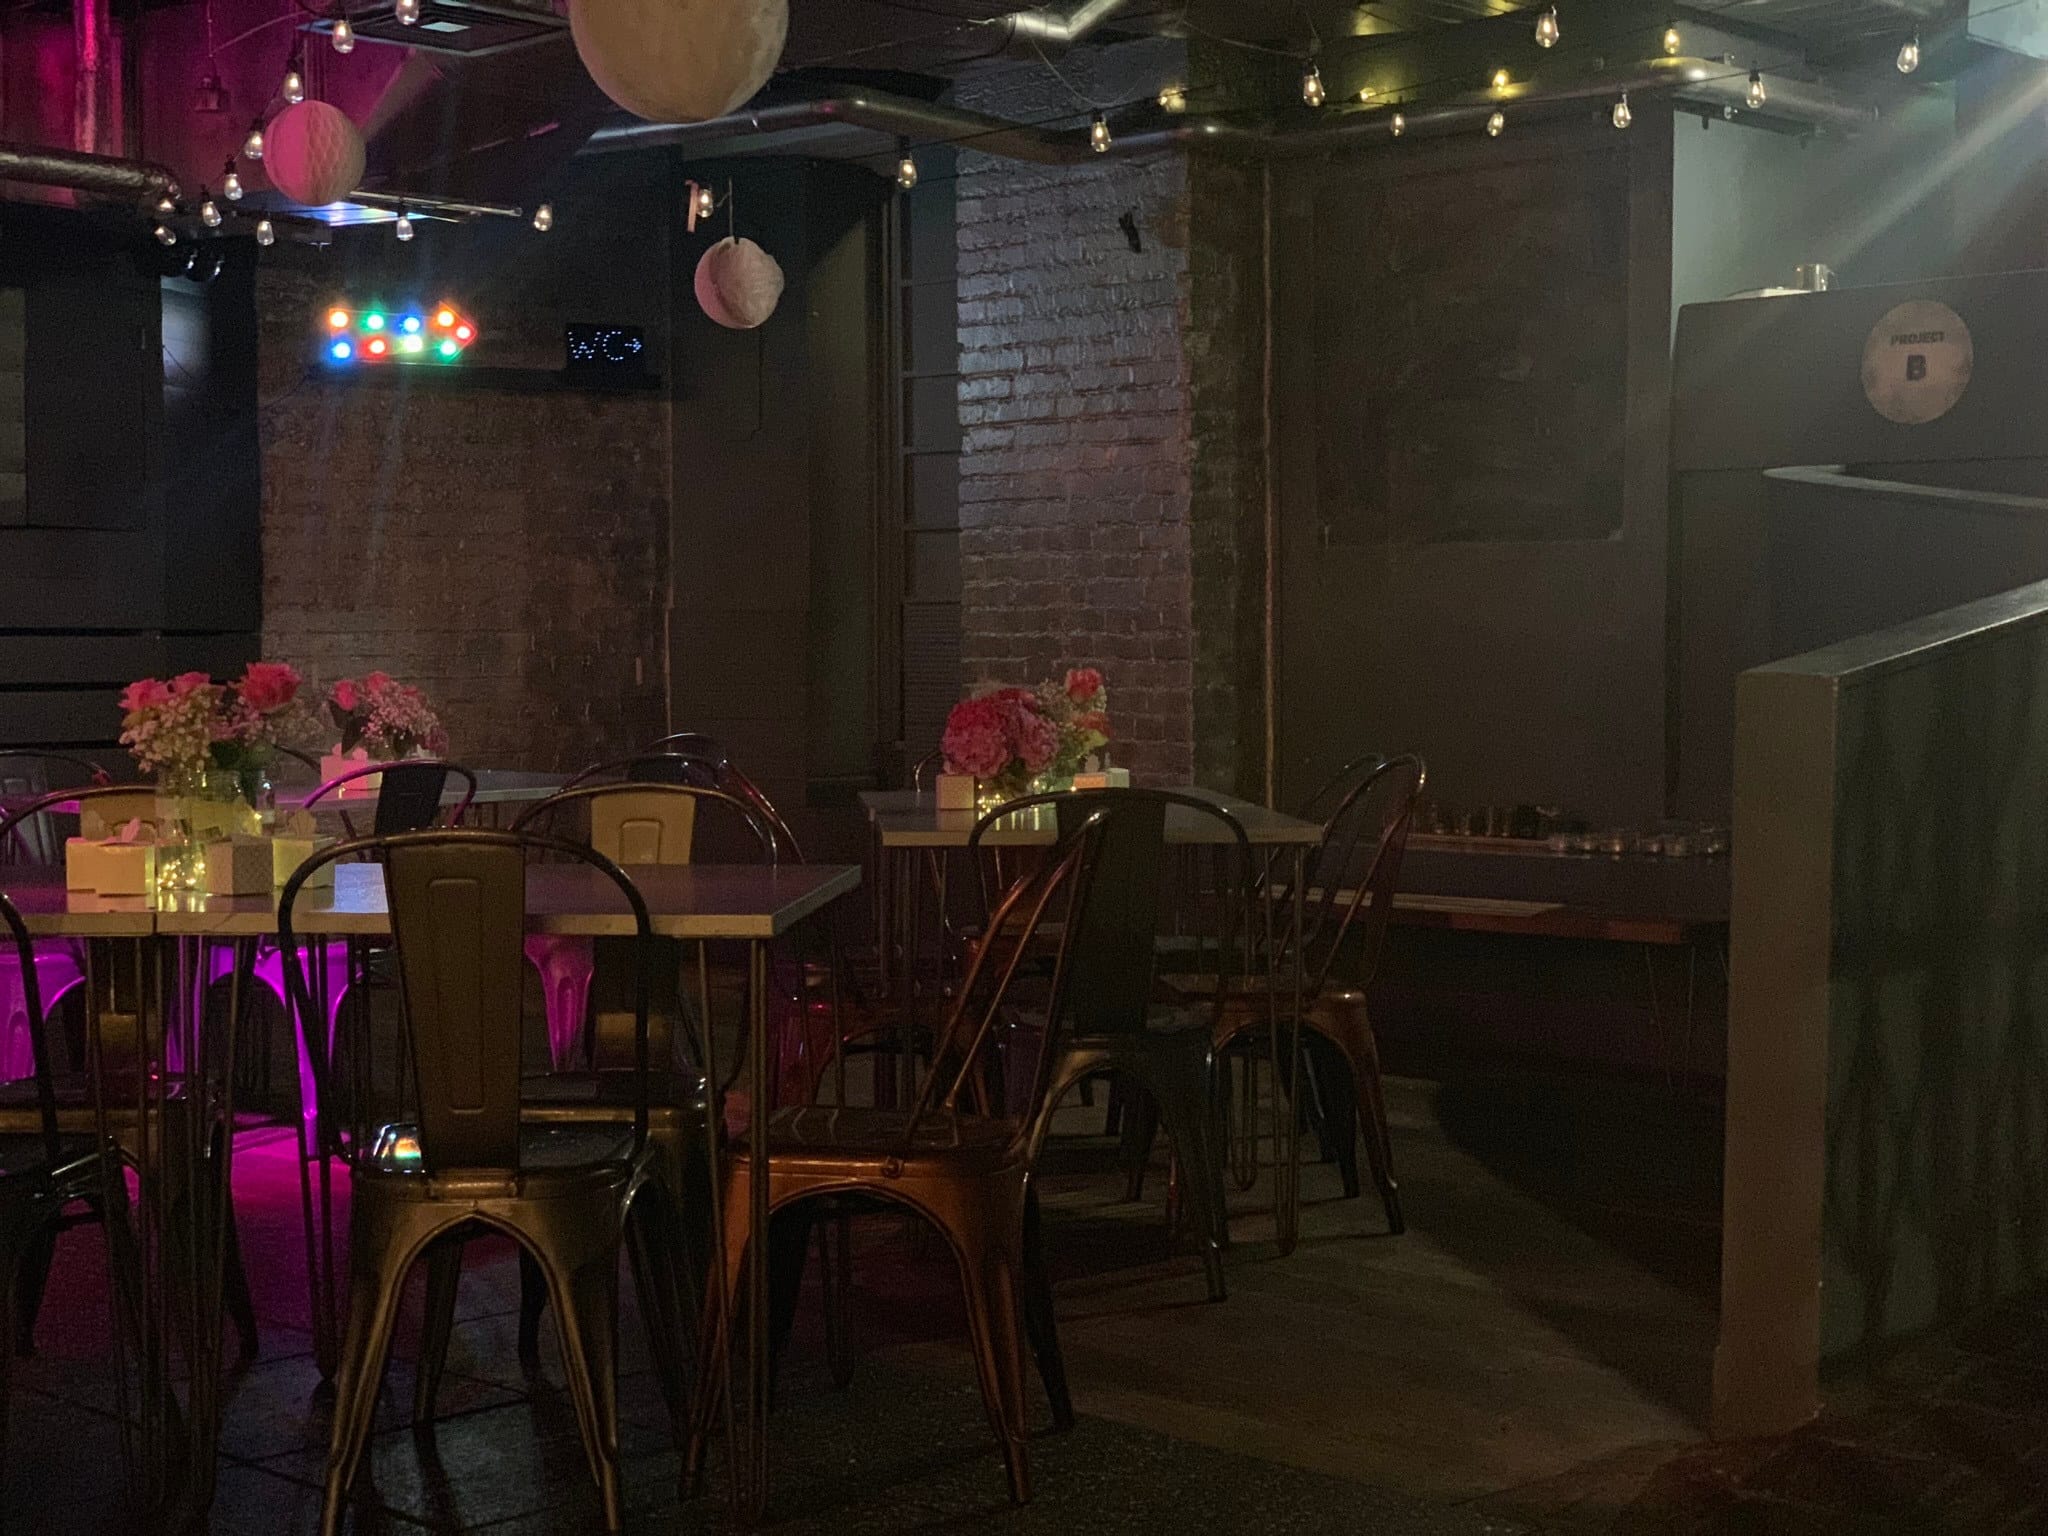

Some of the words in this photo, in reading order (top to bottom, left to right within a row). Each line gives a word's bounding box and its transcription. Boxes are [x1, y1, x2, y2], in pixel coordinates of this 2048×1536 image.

[568, 331, 624, 361] WC
[1890, 331, 1945, 345] PROJECT
[1906, 354, 1927, 381] B
